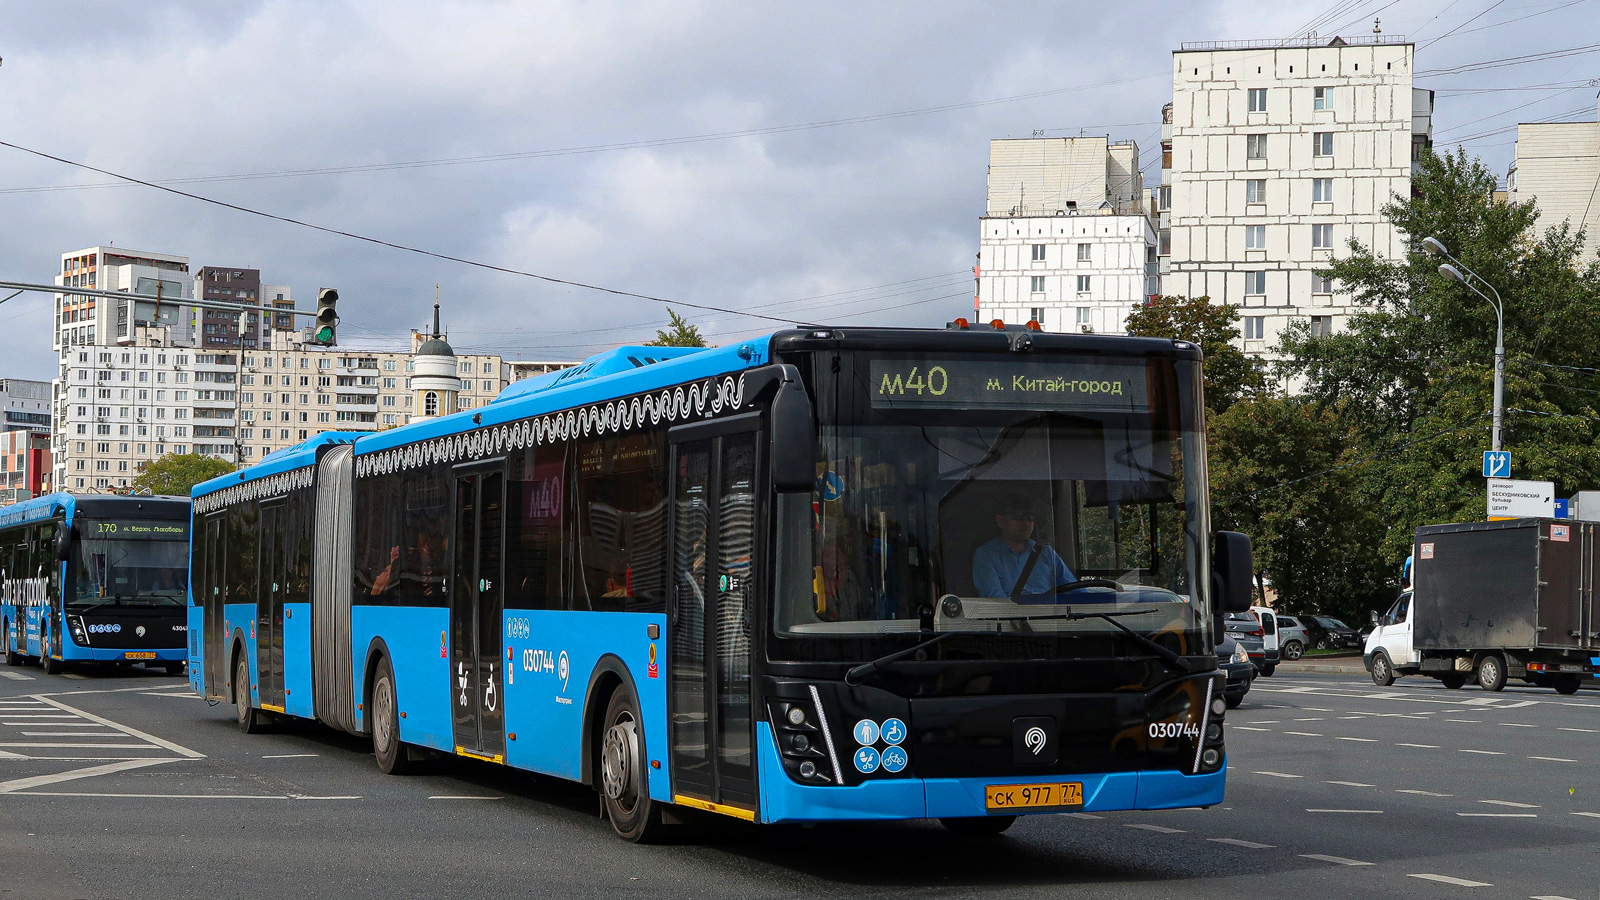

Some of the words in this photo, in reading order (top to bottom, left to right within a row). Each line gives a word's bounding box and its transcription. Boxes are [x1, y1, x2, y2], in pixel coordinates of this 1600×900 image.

[986, 379, 1004, 391] м.
[1012, 375, 1123, 396] Китай-город
[1492, 491, 1540, 499] БЕСКУДНИКОВСКИЙ
[98, 523, 118, 533] 170
[523, 649, 555, 674] 030744
[1149, 722, 1199, 738] 030744
[994, 792, 1015, 805] СК
[1021, 786, 1051, 804] 977
[1061, 784, 1076, 798] 77
